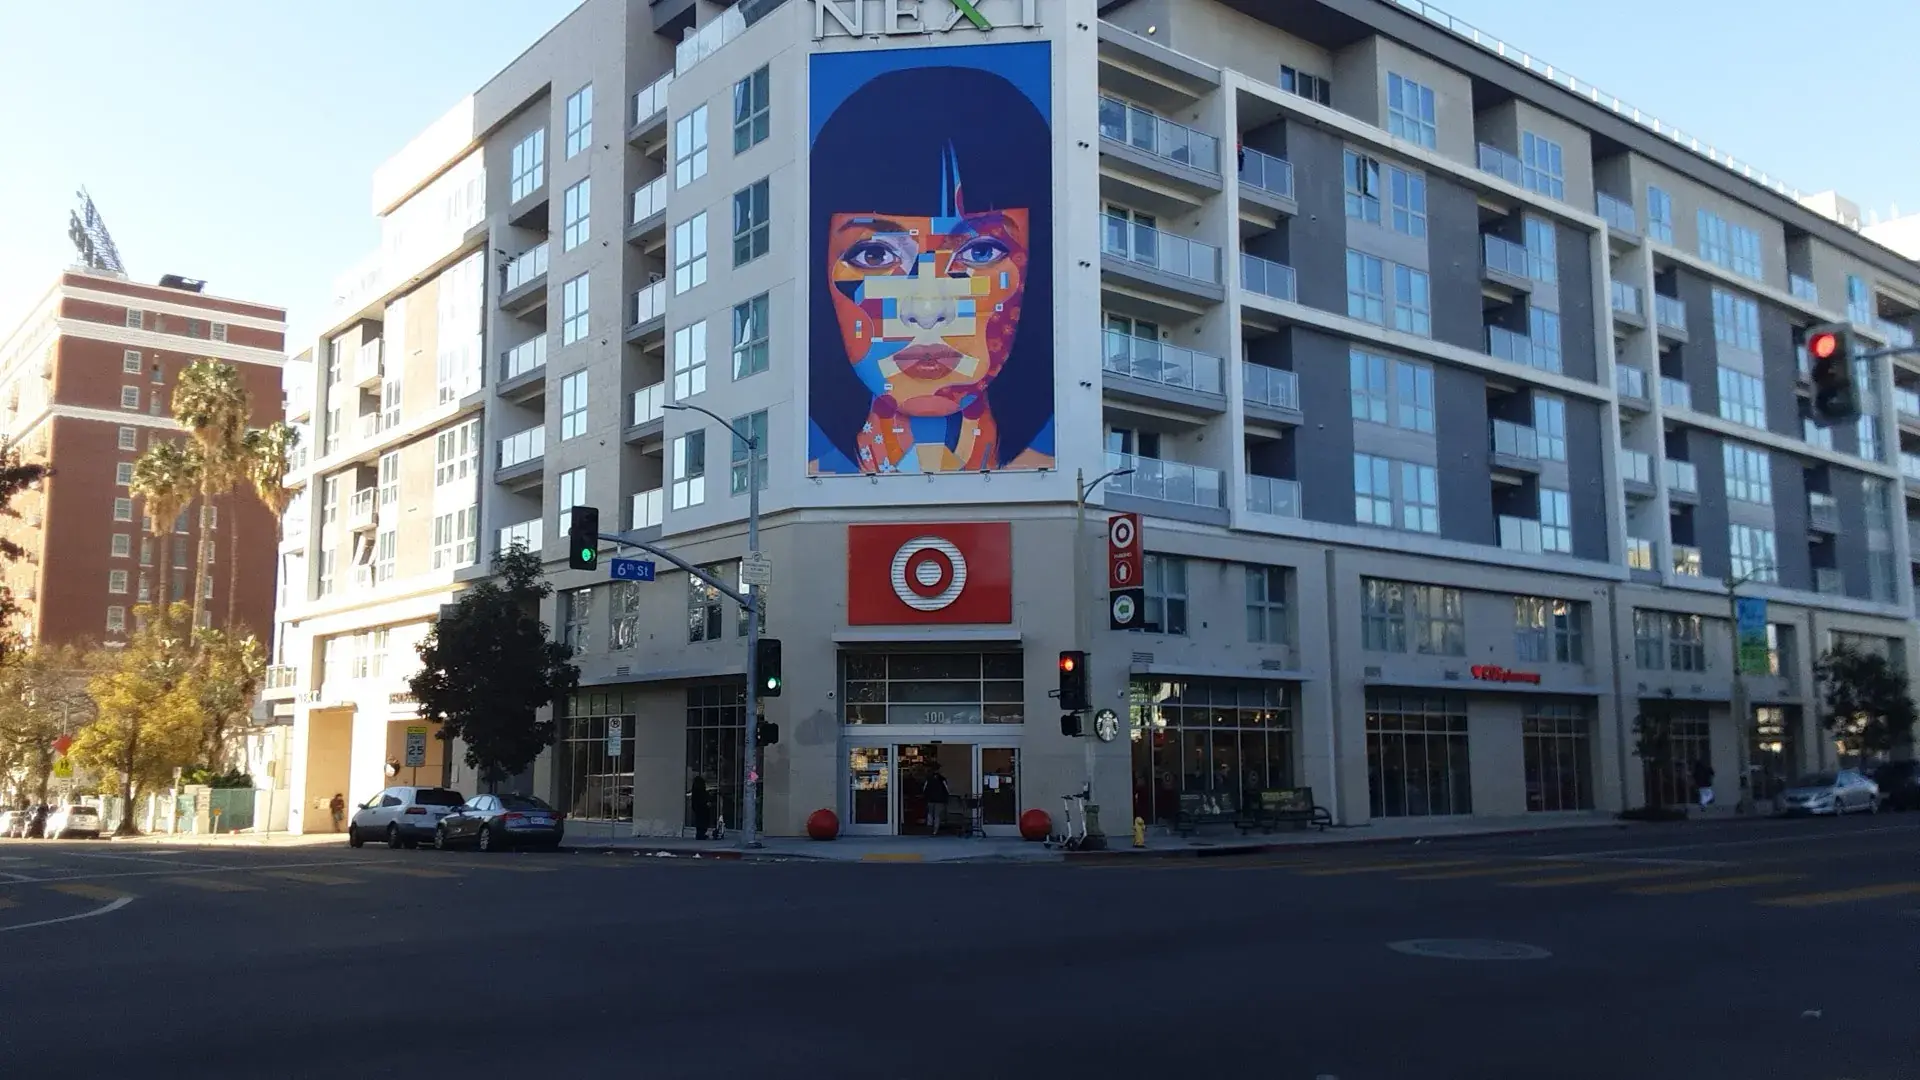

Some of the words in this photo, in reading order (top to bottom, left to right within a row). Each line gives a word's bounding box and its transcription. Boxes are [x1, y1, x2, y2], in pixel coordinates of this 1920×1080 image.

[617, 562, 635, 576] 6th
[637, 565, 649, 577] St
[924, 711, 945, 723] 100
[408, 745, 425, 756] 25
